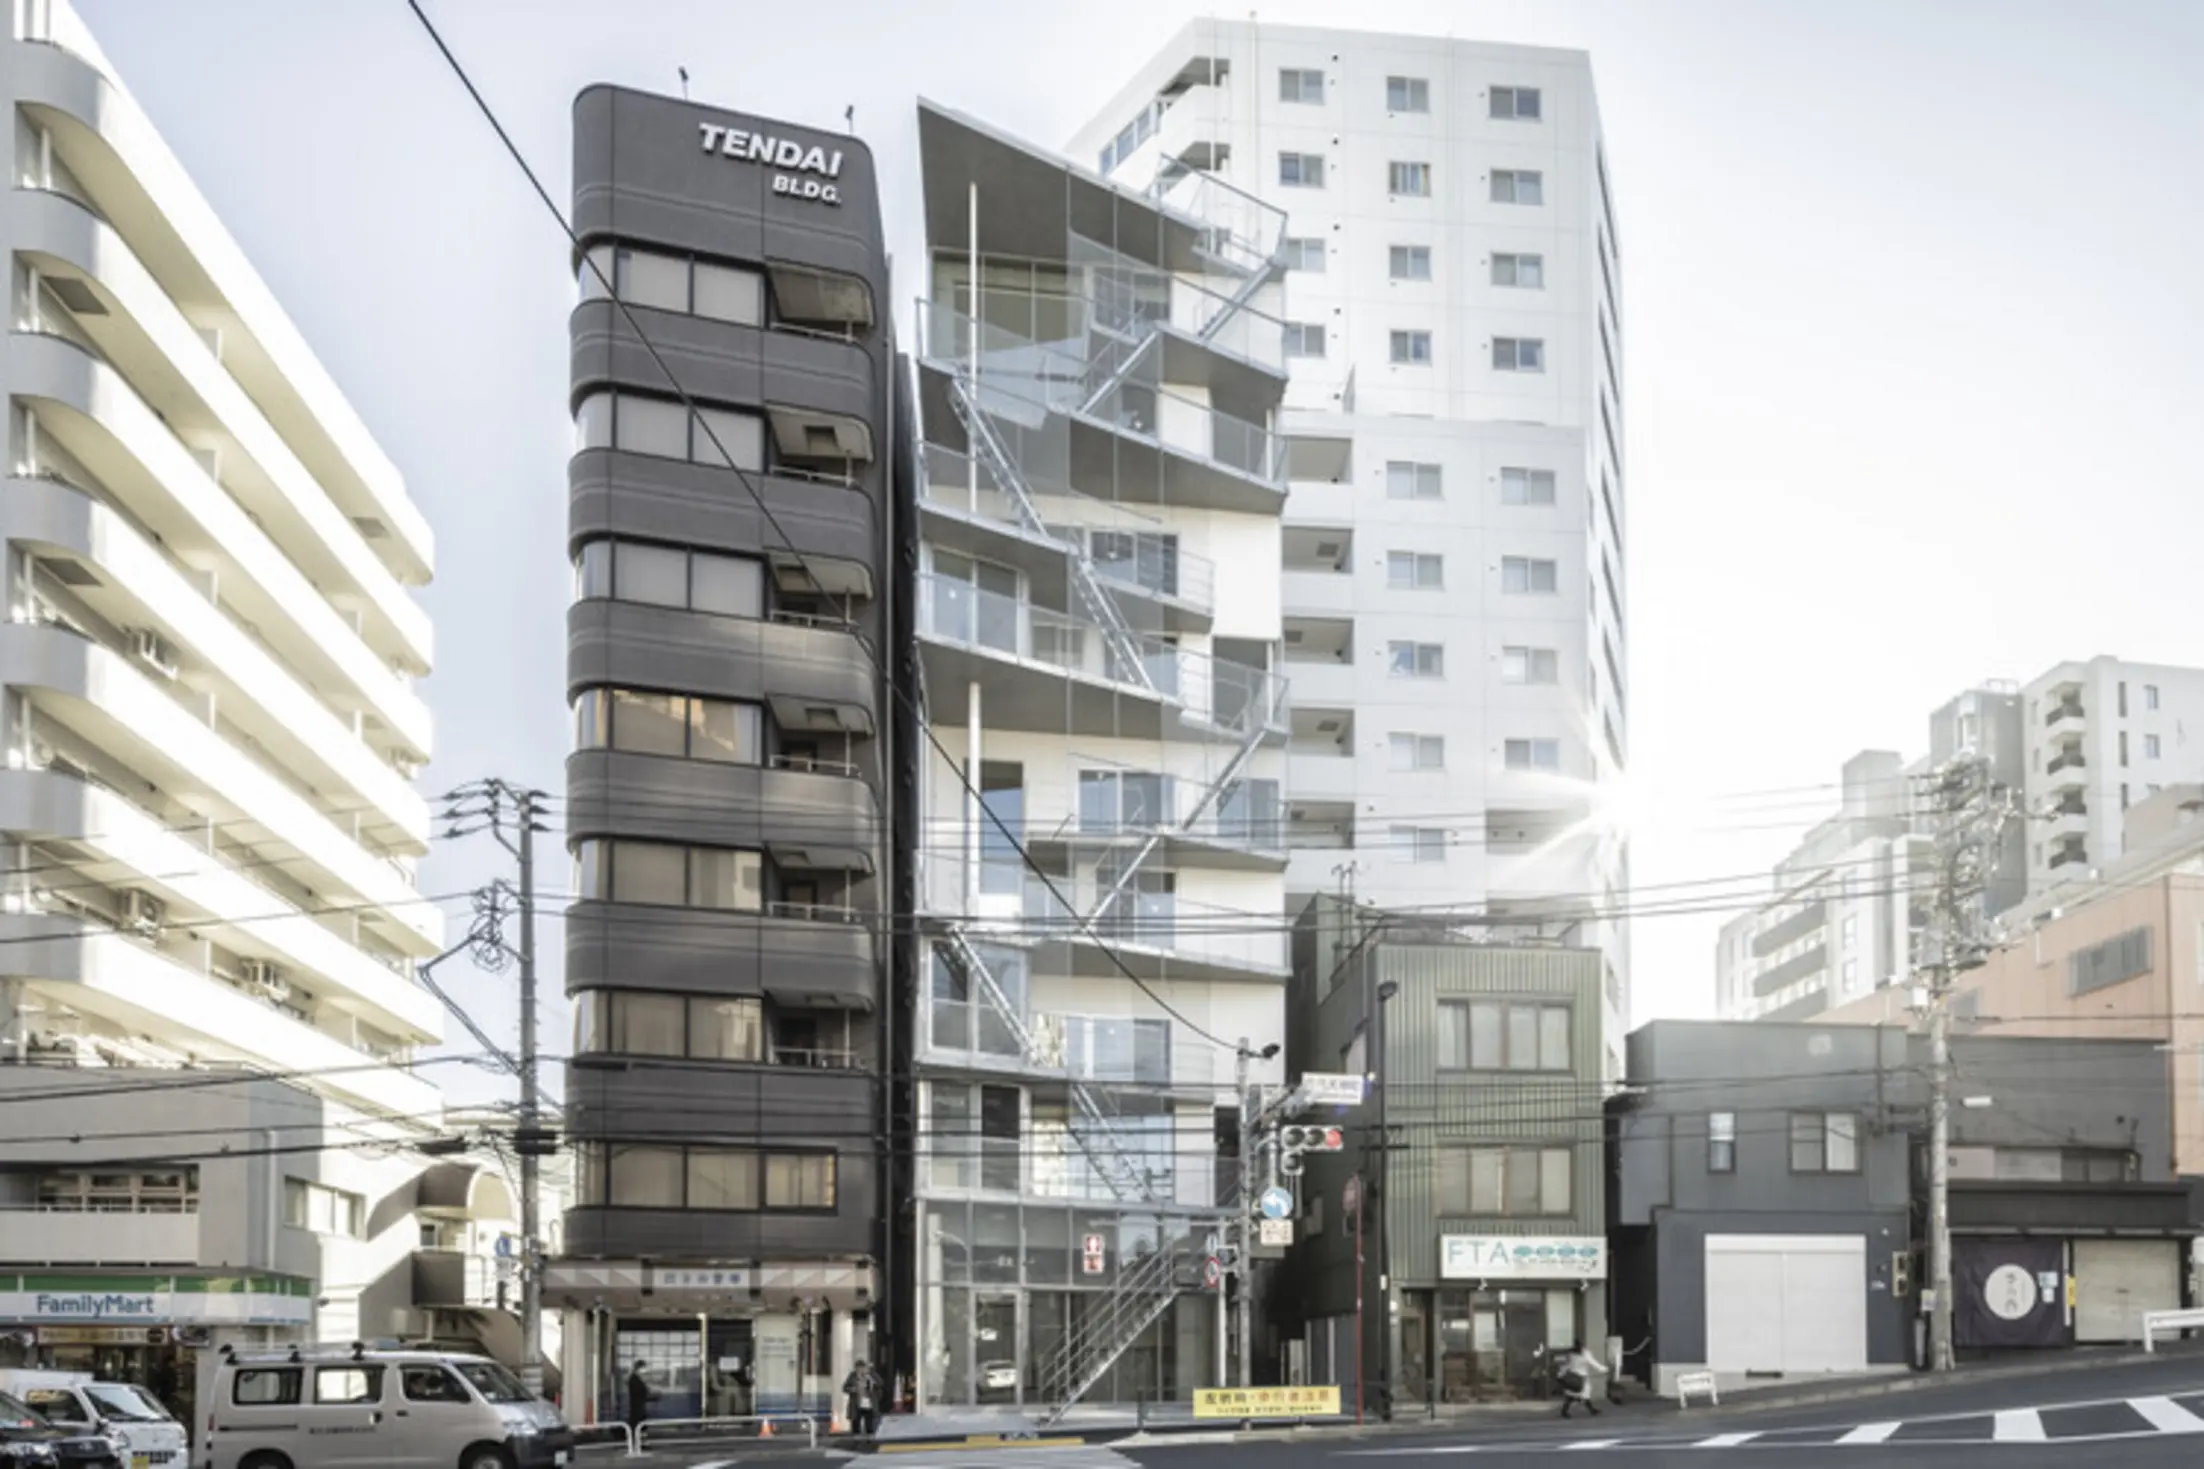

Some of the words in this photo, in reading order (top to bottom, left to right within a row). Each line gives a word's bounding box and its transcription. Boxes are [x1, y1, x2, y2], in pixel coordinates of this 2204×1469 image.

[699, 123, 842, 176] TENDAI
[772, 175, 841, 204] BLDG.
[1448, 1240, 1509, 1264] FTA
[36, 1294, 154, 1318] FamilyMart
